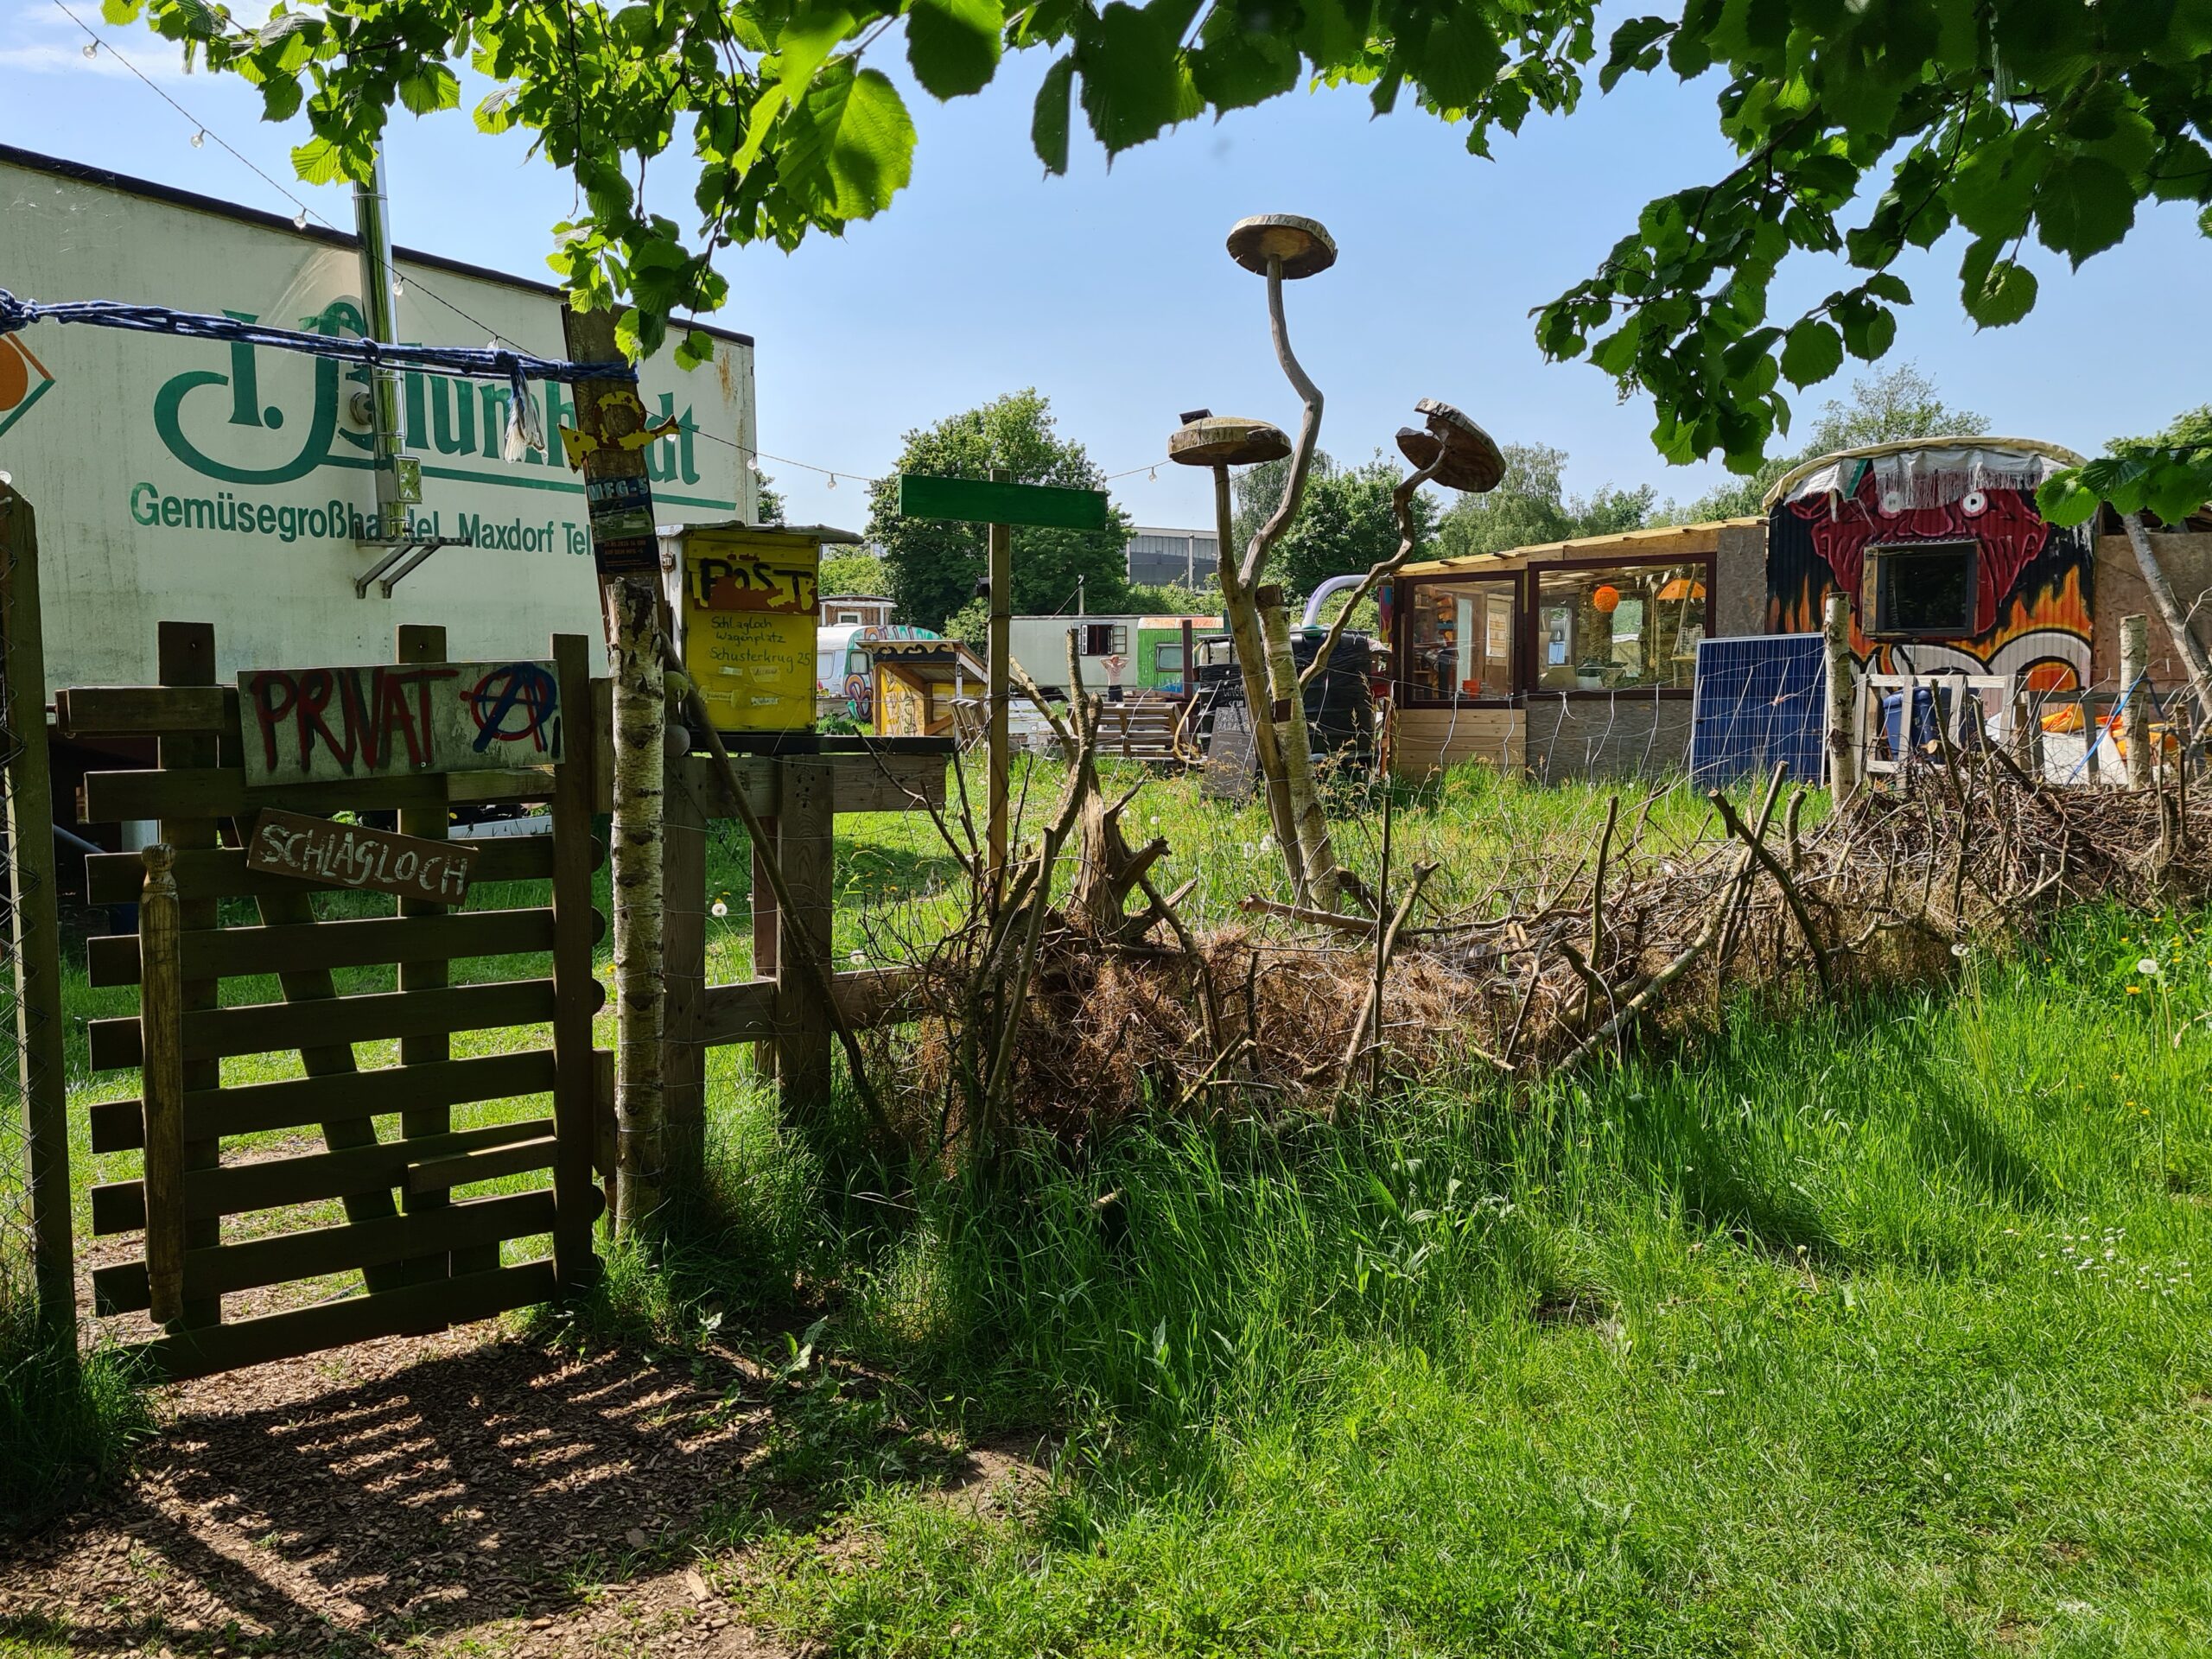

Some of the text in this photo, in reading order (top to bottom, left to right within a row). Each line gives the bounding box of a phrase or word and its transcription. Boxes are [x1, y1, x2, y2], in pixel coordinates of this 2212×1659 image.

[154, 302, 701, 486] Blumhdt
[130, 481, 440, 543] Gemüsegroßhael
[458, 512, 555, 553] Maxdorf
[587, 478, 649, 501] MFG-5
[709, 647, 794, 673] Schusterkrug
[797, 652, 811, 665] 25
[250, 667, 460, 776] PRIVAT
[260, 823, 468, 896] SCHLAGLOCH
